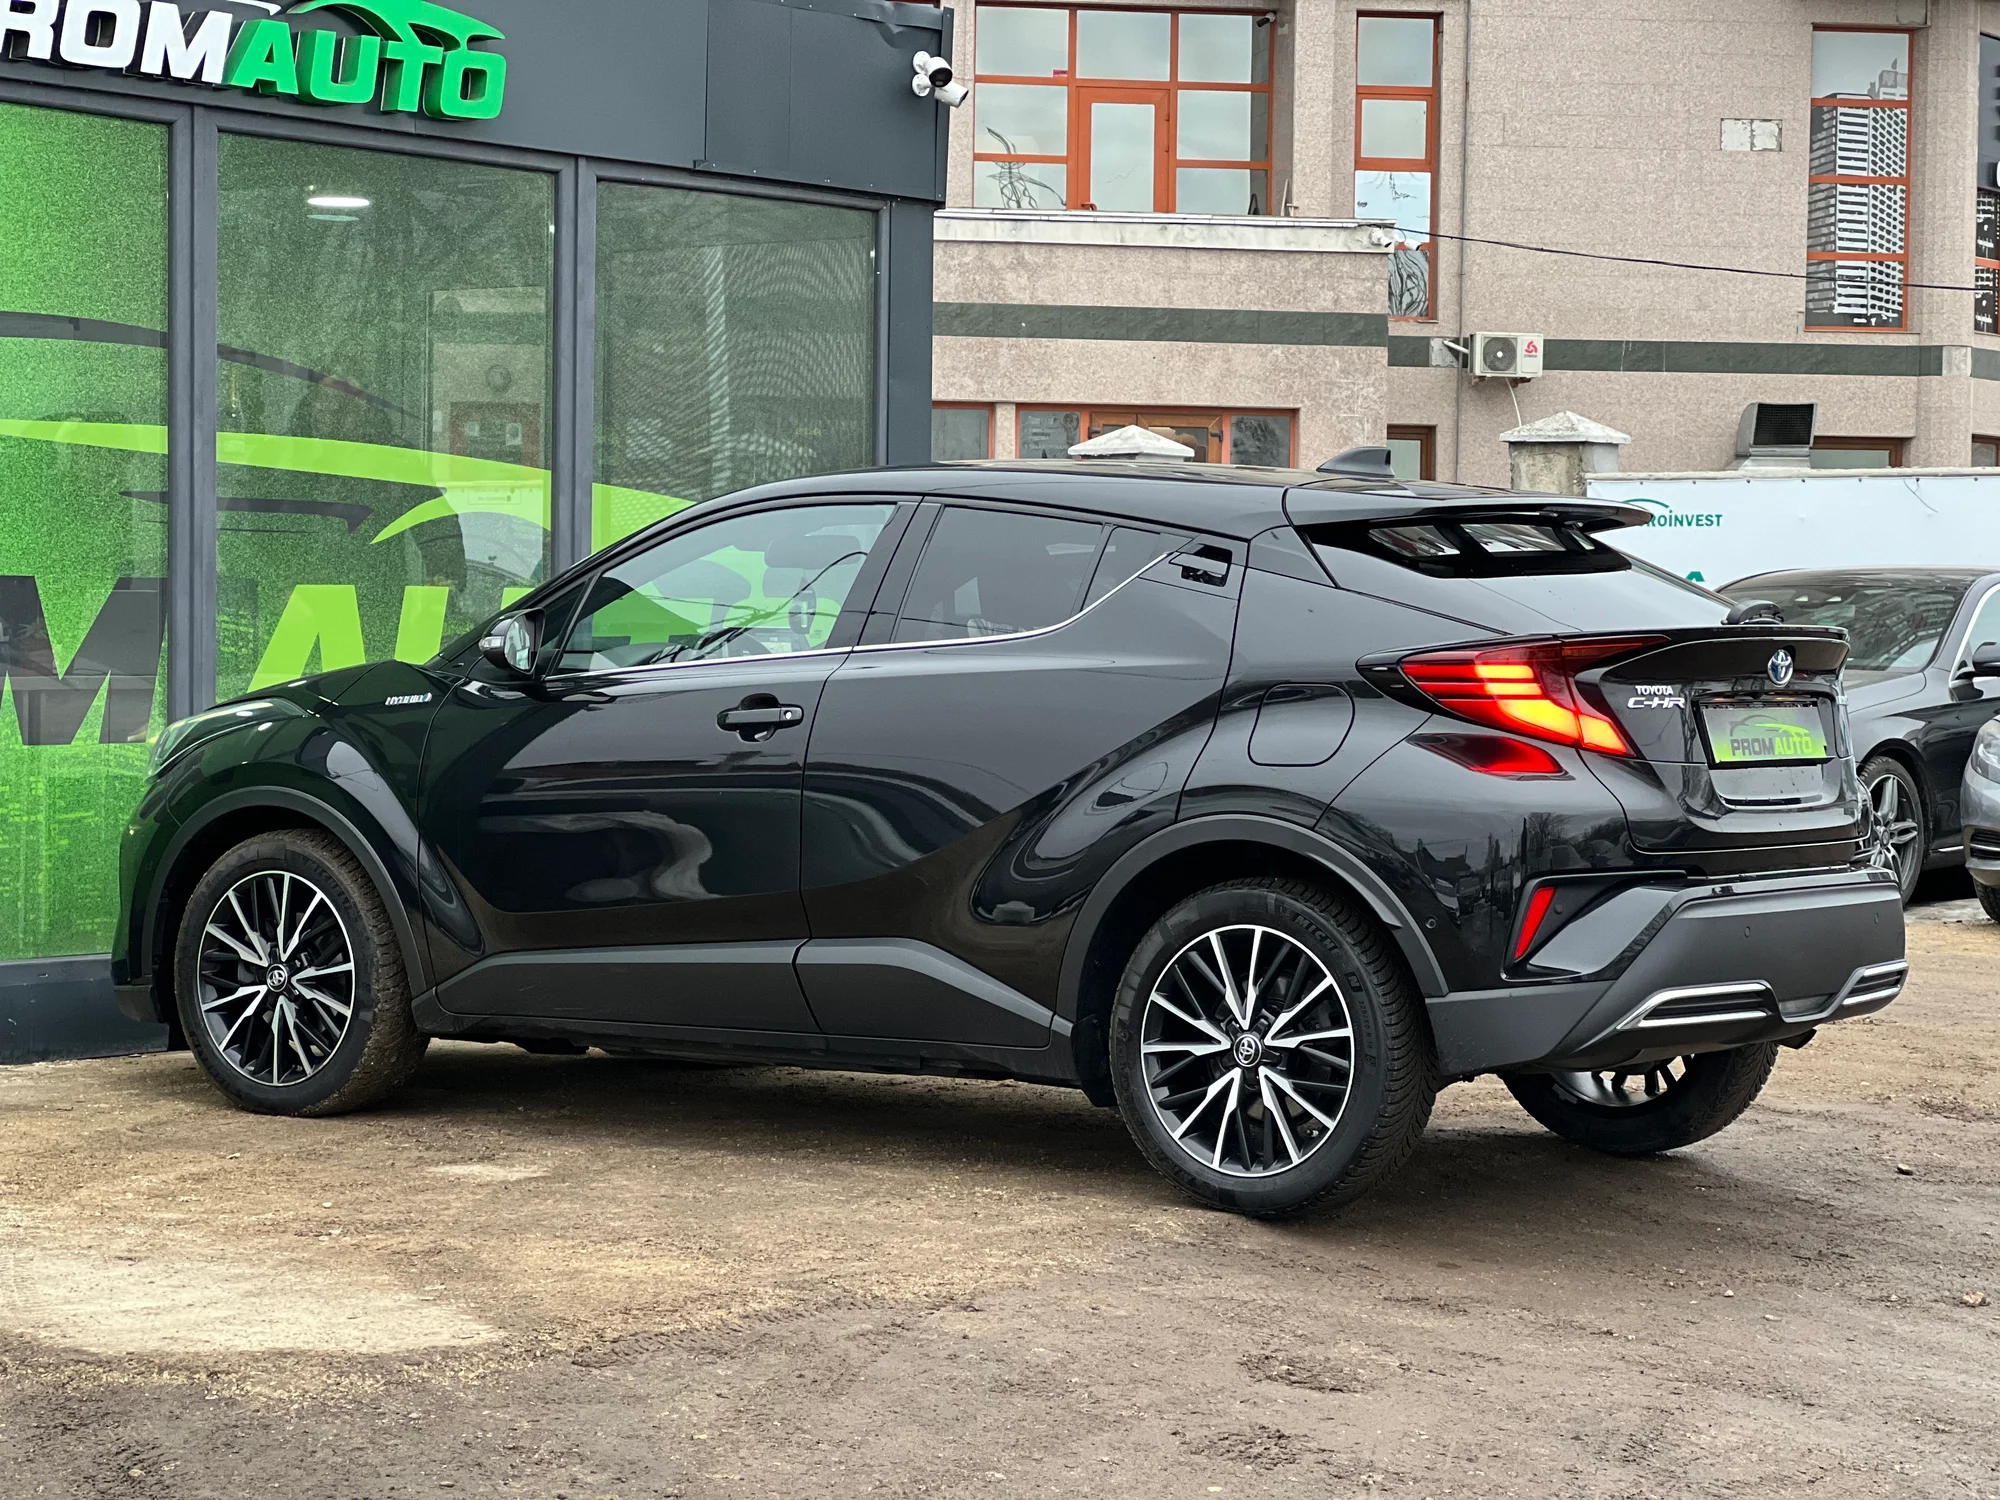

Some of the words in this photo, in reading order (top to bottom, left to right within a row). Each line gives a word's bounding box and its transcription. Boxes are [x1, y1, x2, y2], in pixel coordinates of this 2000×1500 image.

[1635, 685, 1673, 696] TOYOTA
[1627, 697, 1685, 709] C-HR
[1730, 736, 1812, 757] PROMAUTO
